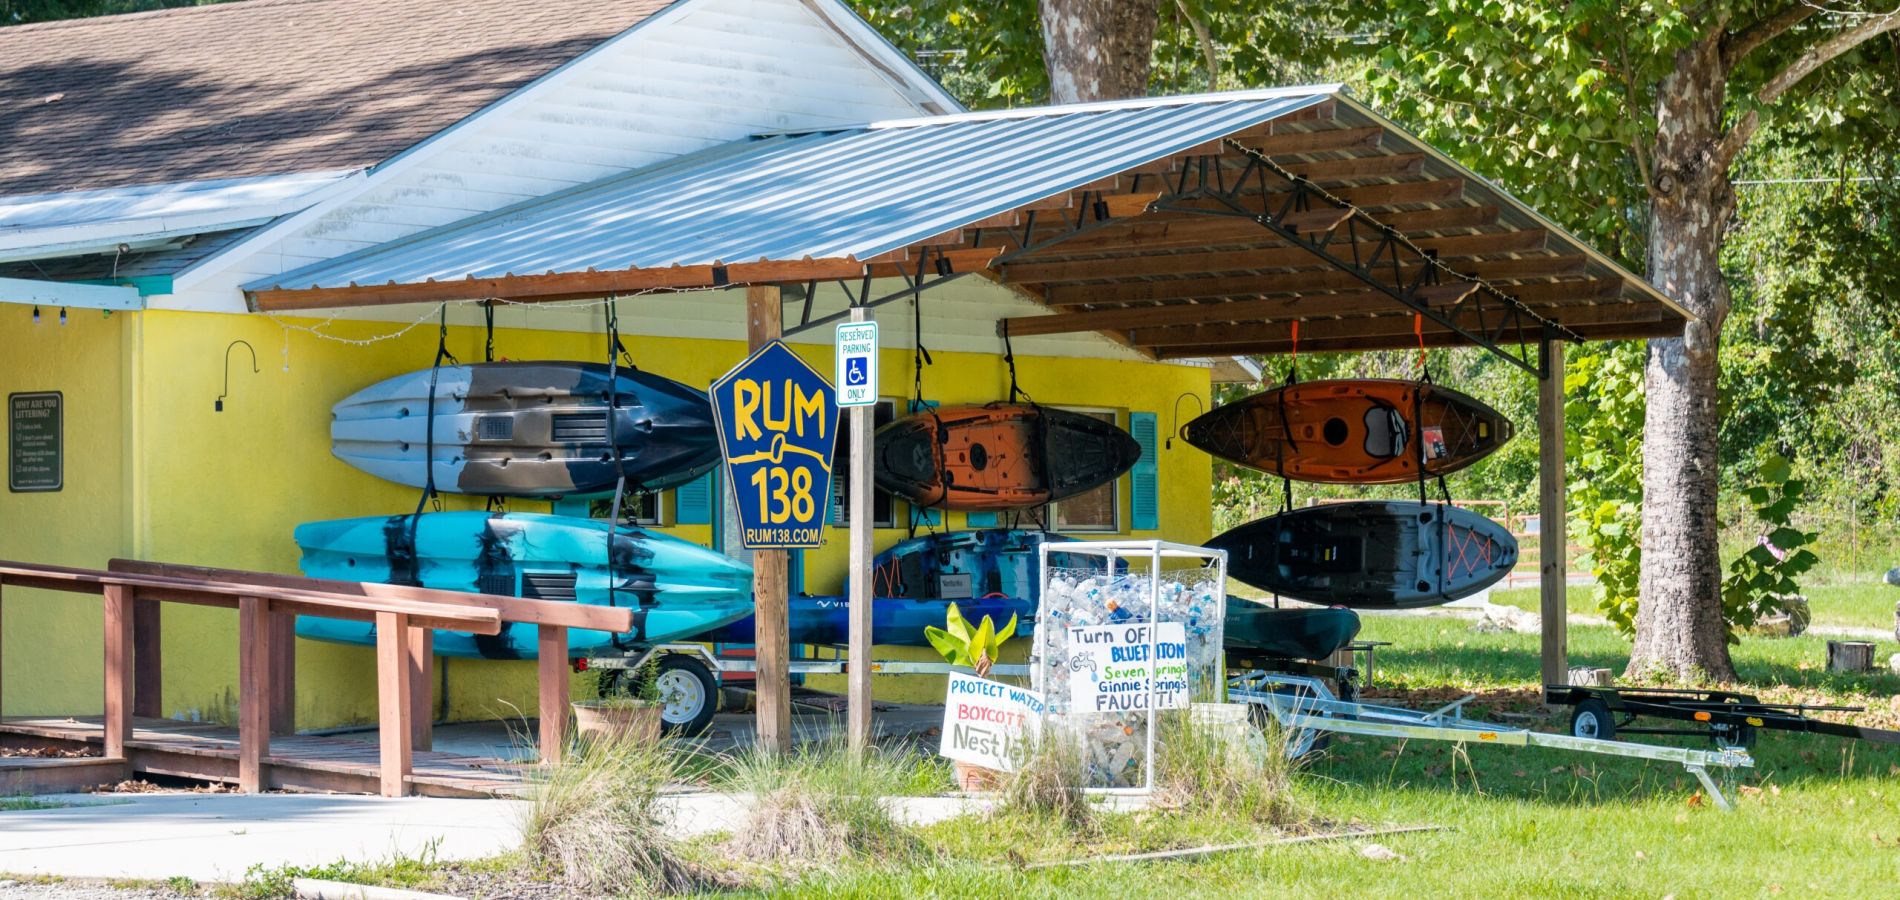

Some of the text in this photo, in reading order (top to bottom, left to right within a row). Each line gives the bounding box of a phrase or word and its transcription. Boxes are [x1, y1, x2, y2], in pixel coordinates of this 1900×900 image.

[840, 330, 873, 341] RESERVED
[843, 343, 871, 354] PARKING
[847, 389, 866, 399] ONLY
[15, 399, 57, 409] WHY ARE YOU
[733, 378, 825, 441] RUM
[15, 409, 50, 419] LITTERING?
[751, 466, 815, 524] 138
[746, 528, 819, 543] RUM138.COM
[1072, 627, 1151, 644] Turn OF
[1111, 642, 1185, 662] BLUETITON
[1104, 666, 1145, 680] Seven
[1099, 679, 1141, 693] Ginnie
[951, 680, 1045, 715] PROTECT WATER
[958, 703, 1026, 728] BOYCOTT
